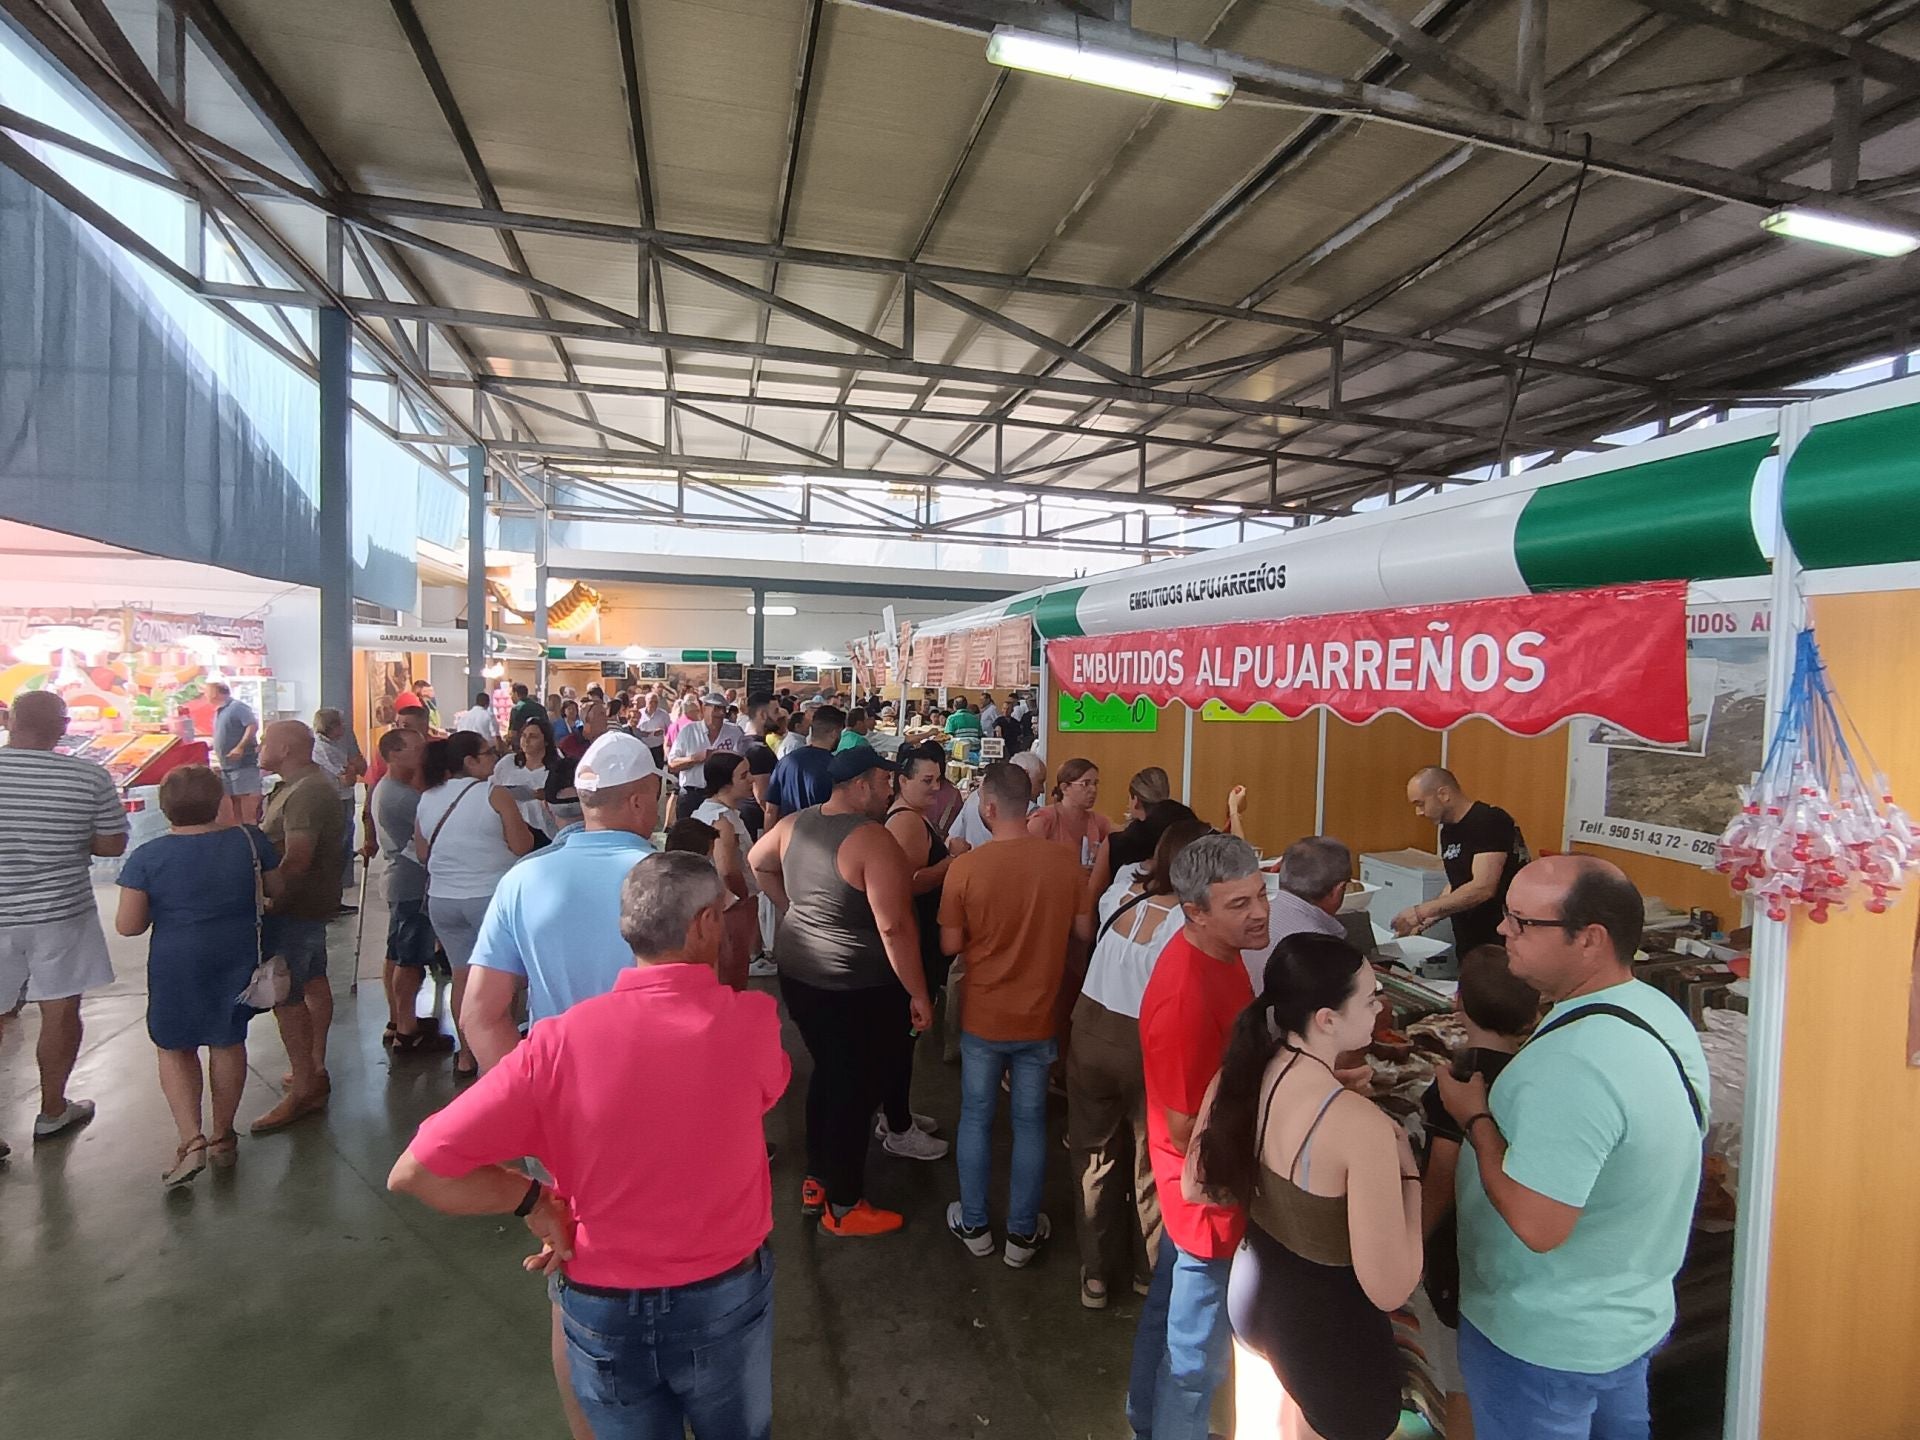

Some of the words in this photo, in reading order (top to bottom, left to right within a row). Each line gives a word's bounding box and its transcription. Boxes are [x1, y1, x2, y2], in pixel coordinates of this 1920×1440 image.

[1129, 582, 1183, 611] EMBUTIDOS
[1186, 562, 1287, 603] ALPUJARREÑOS
[1071, 647, 1184, 686] EMBUTIDOS
[1194, 621, 1547, 693] ALPUJARREÑOS
[1073, 700, 1085, 724] 3
[1579, 819, 1606, 836] Telf.
[1608, 824, 1630, 840] 950
[1631, 828, 1645, 842] 51
[1646, 831, 1662, 846] 43
[1665, 834, 1681, 849] 72
[1691, 838, 1716, 856] 626
